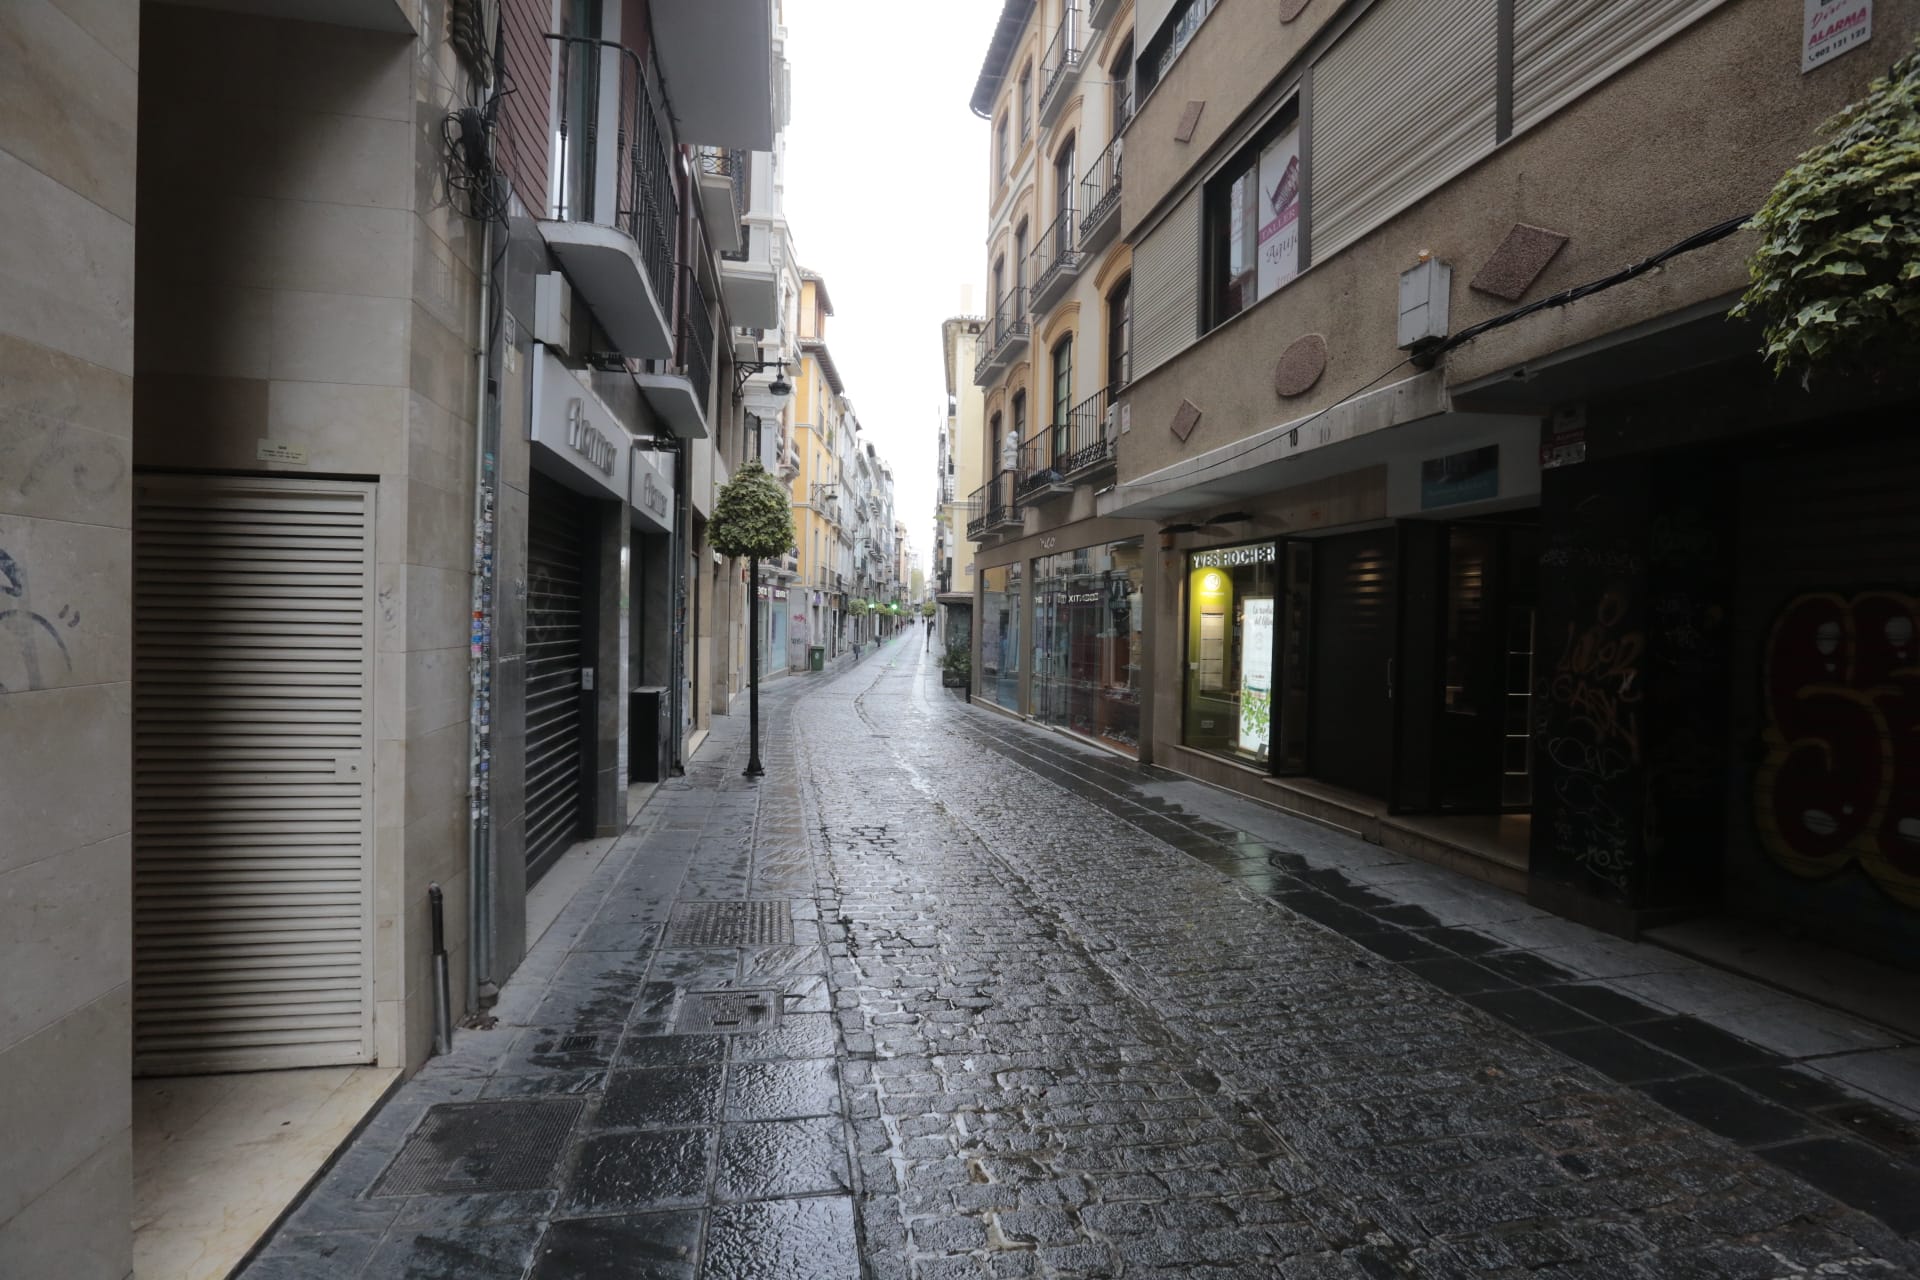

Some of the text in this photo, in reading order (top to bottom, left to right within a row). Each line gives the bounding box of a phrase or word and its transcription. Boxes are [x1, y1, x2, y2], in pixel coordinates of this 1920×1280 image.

[1808, 7, 1867, 46] ALARMA
[1262, 209, 1296, 239] TALLER
[1289, 428, 1298, 448] 10
[1193, 546, 1276, 568] YVES ROCHER
